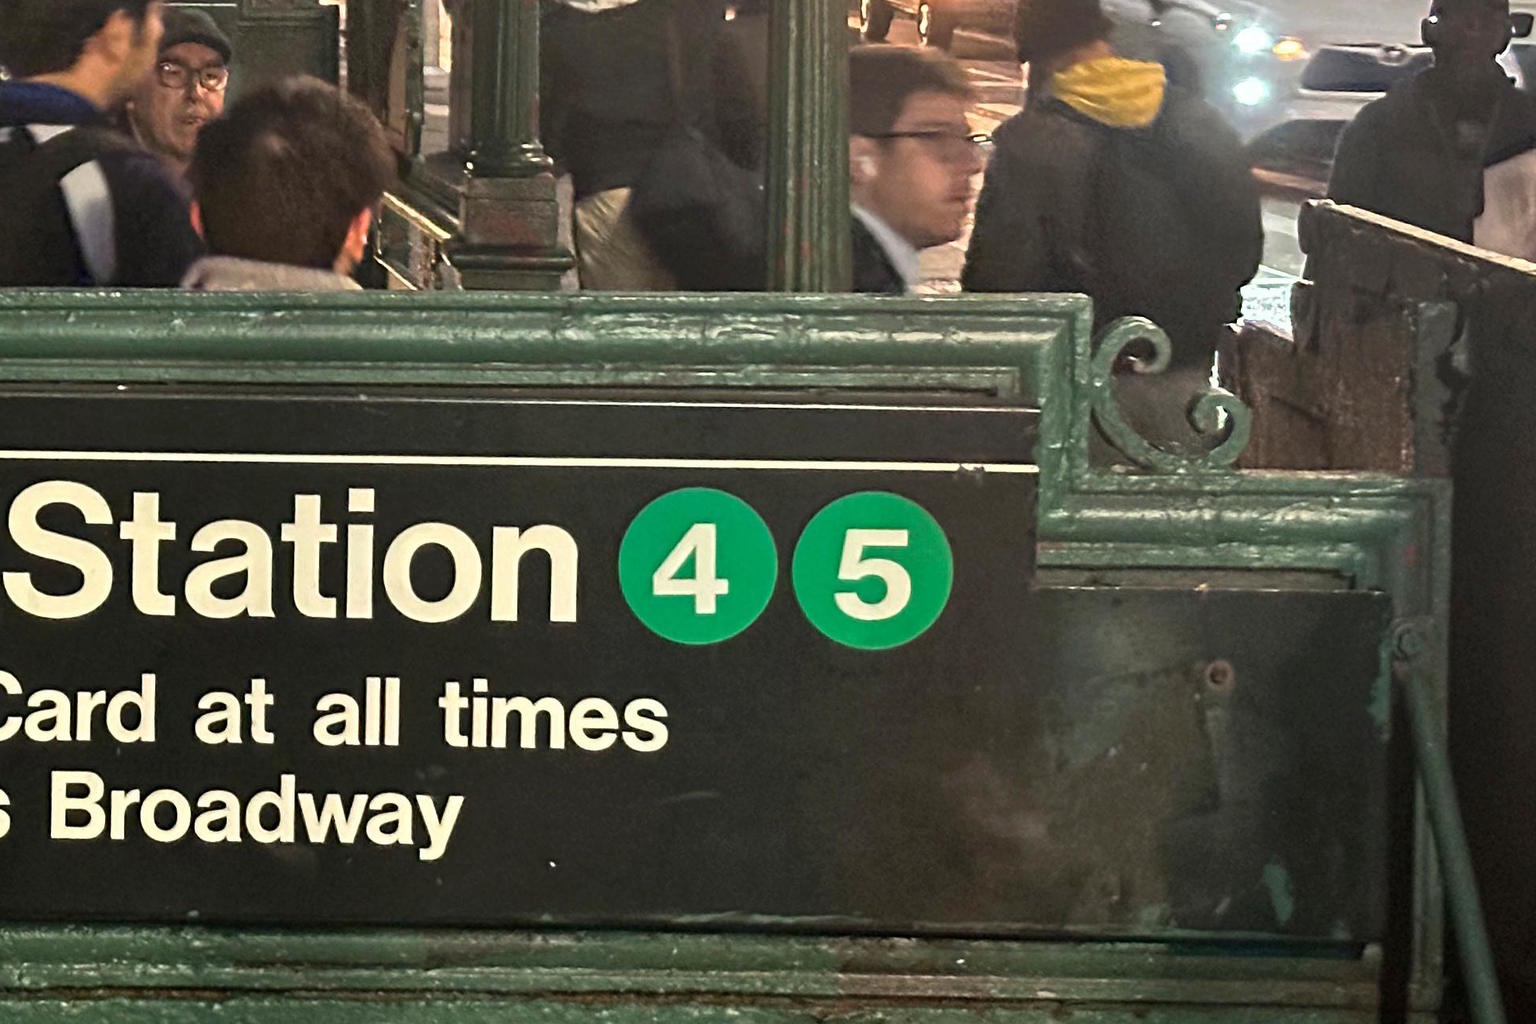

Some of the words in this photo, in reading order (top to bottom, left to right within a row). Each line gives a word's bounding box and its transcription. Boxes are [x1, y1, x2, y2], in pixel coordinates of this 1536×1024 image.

[2, 480, 580, 624] Station
[652, 523, 729, 615] 4
[834, 528, 912, 621] 5
[194, 678, 275, 746] at
[313, 676, 401, 747] all
[438, 678, 670, 753] times
[50, 770, 465, 862] Broadway
